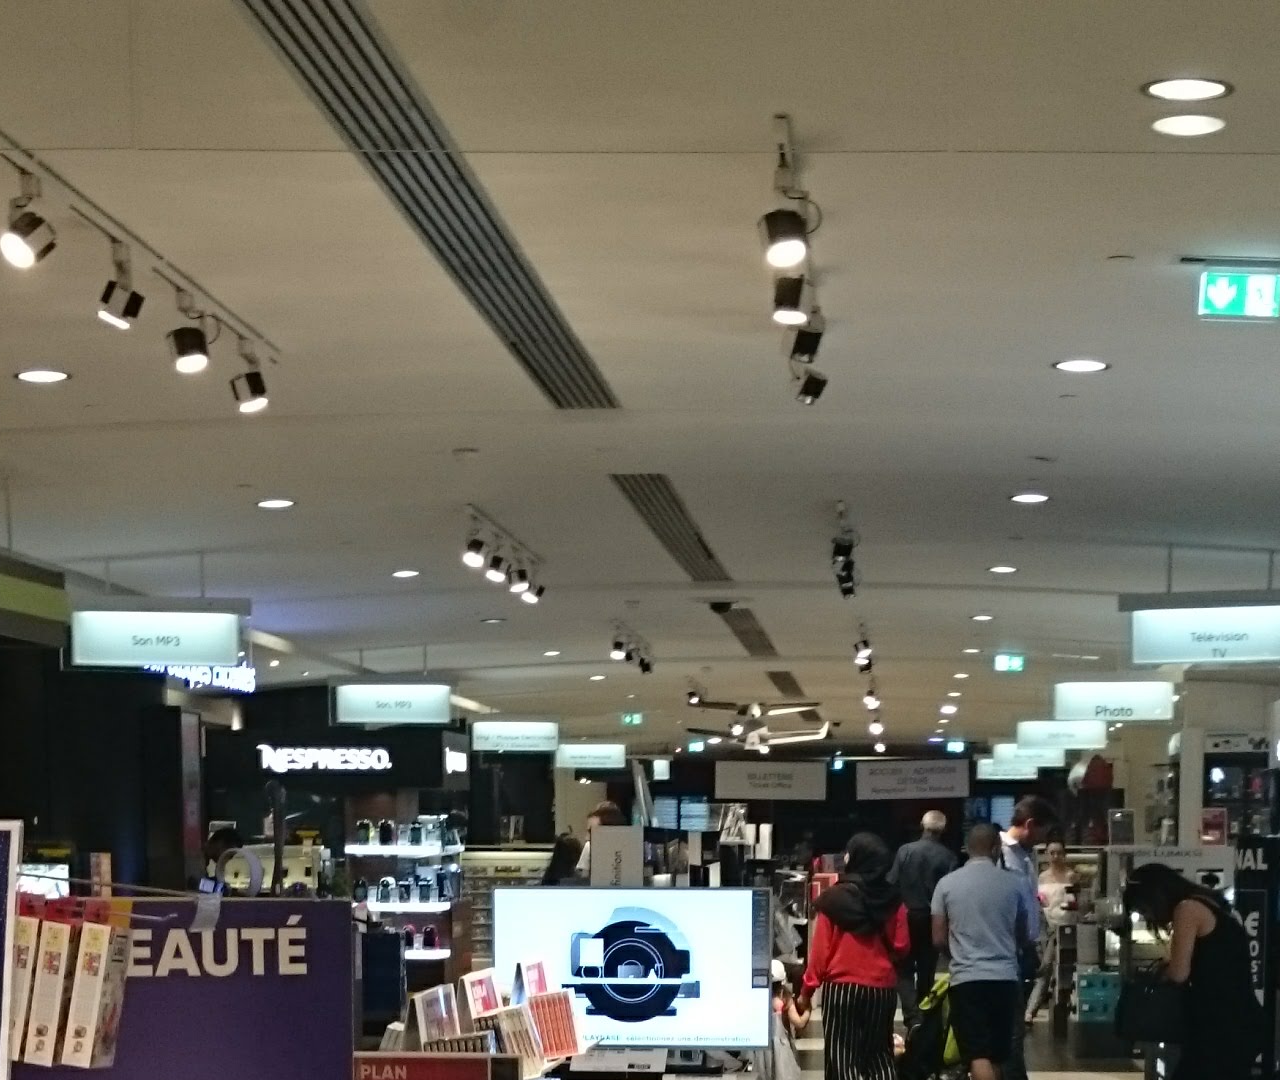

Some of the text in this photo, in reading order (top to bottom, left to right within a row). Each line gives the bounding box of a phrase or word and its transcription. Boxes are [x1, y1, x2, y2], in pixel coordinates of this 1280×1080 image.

[132, 635, 181, 647] Son MP3
[1211, 647, 1227, 658] TV
[1094, 704, 1133, 718] Photo
[129, 914, 308, 978] EAUTÉ
[360, 1064, 407, 1080] PLAN
